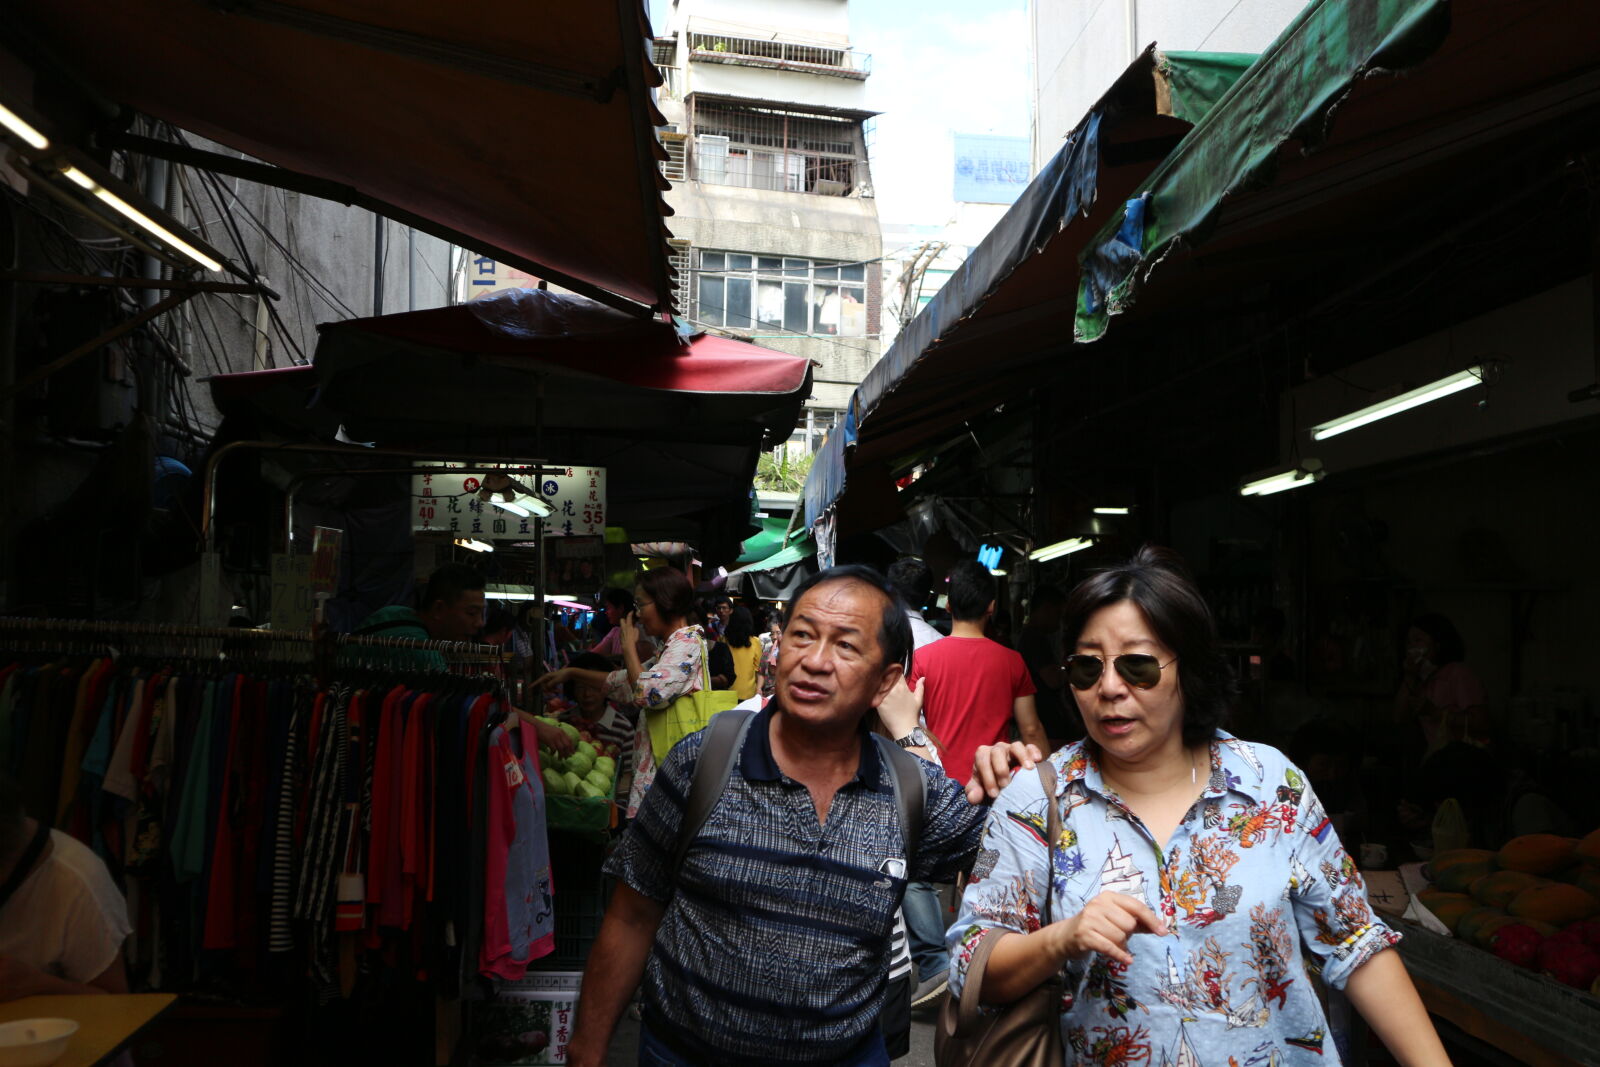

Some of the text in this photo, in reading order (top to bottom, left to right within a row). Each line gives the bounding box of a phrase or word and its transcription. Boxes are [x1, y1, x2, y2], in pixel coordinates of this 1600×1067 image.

[419, 507, 434, 519] 40
[561, 500, 575, 535] 花生
[583, 511, 603, 524] 35
